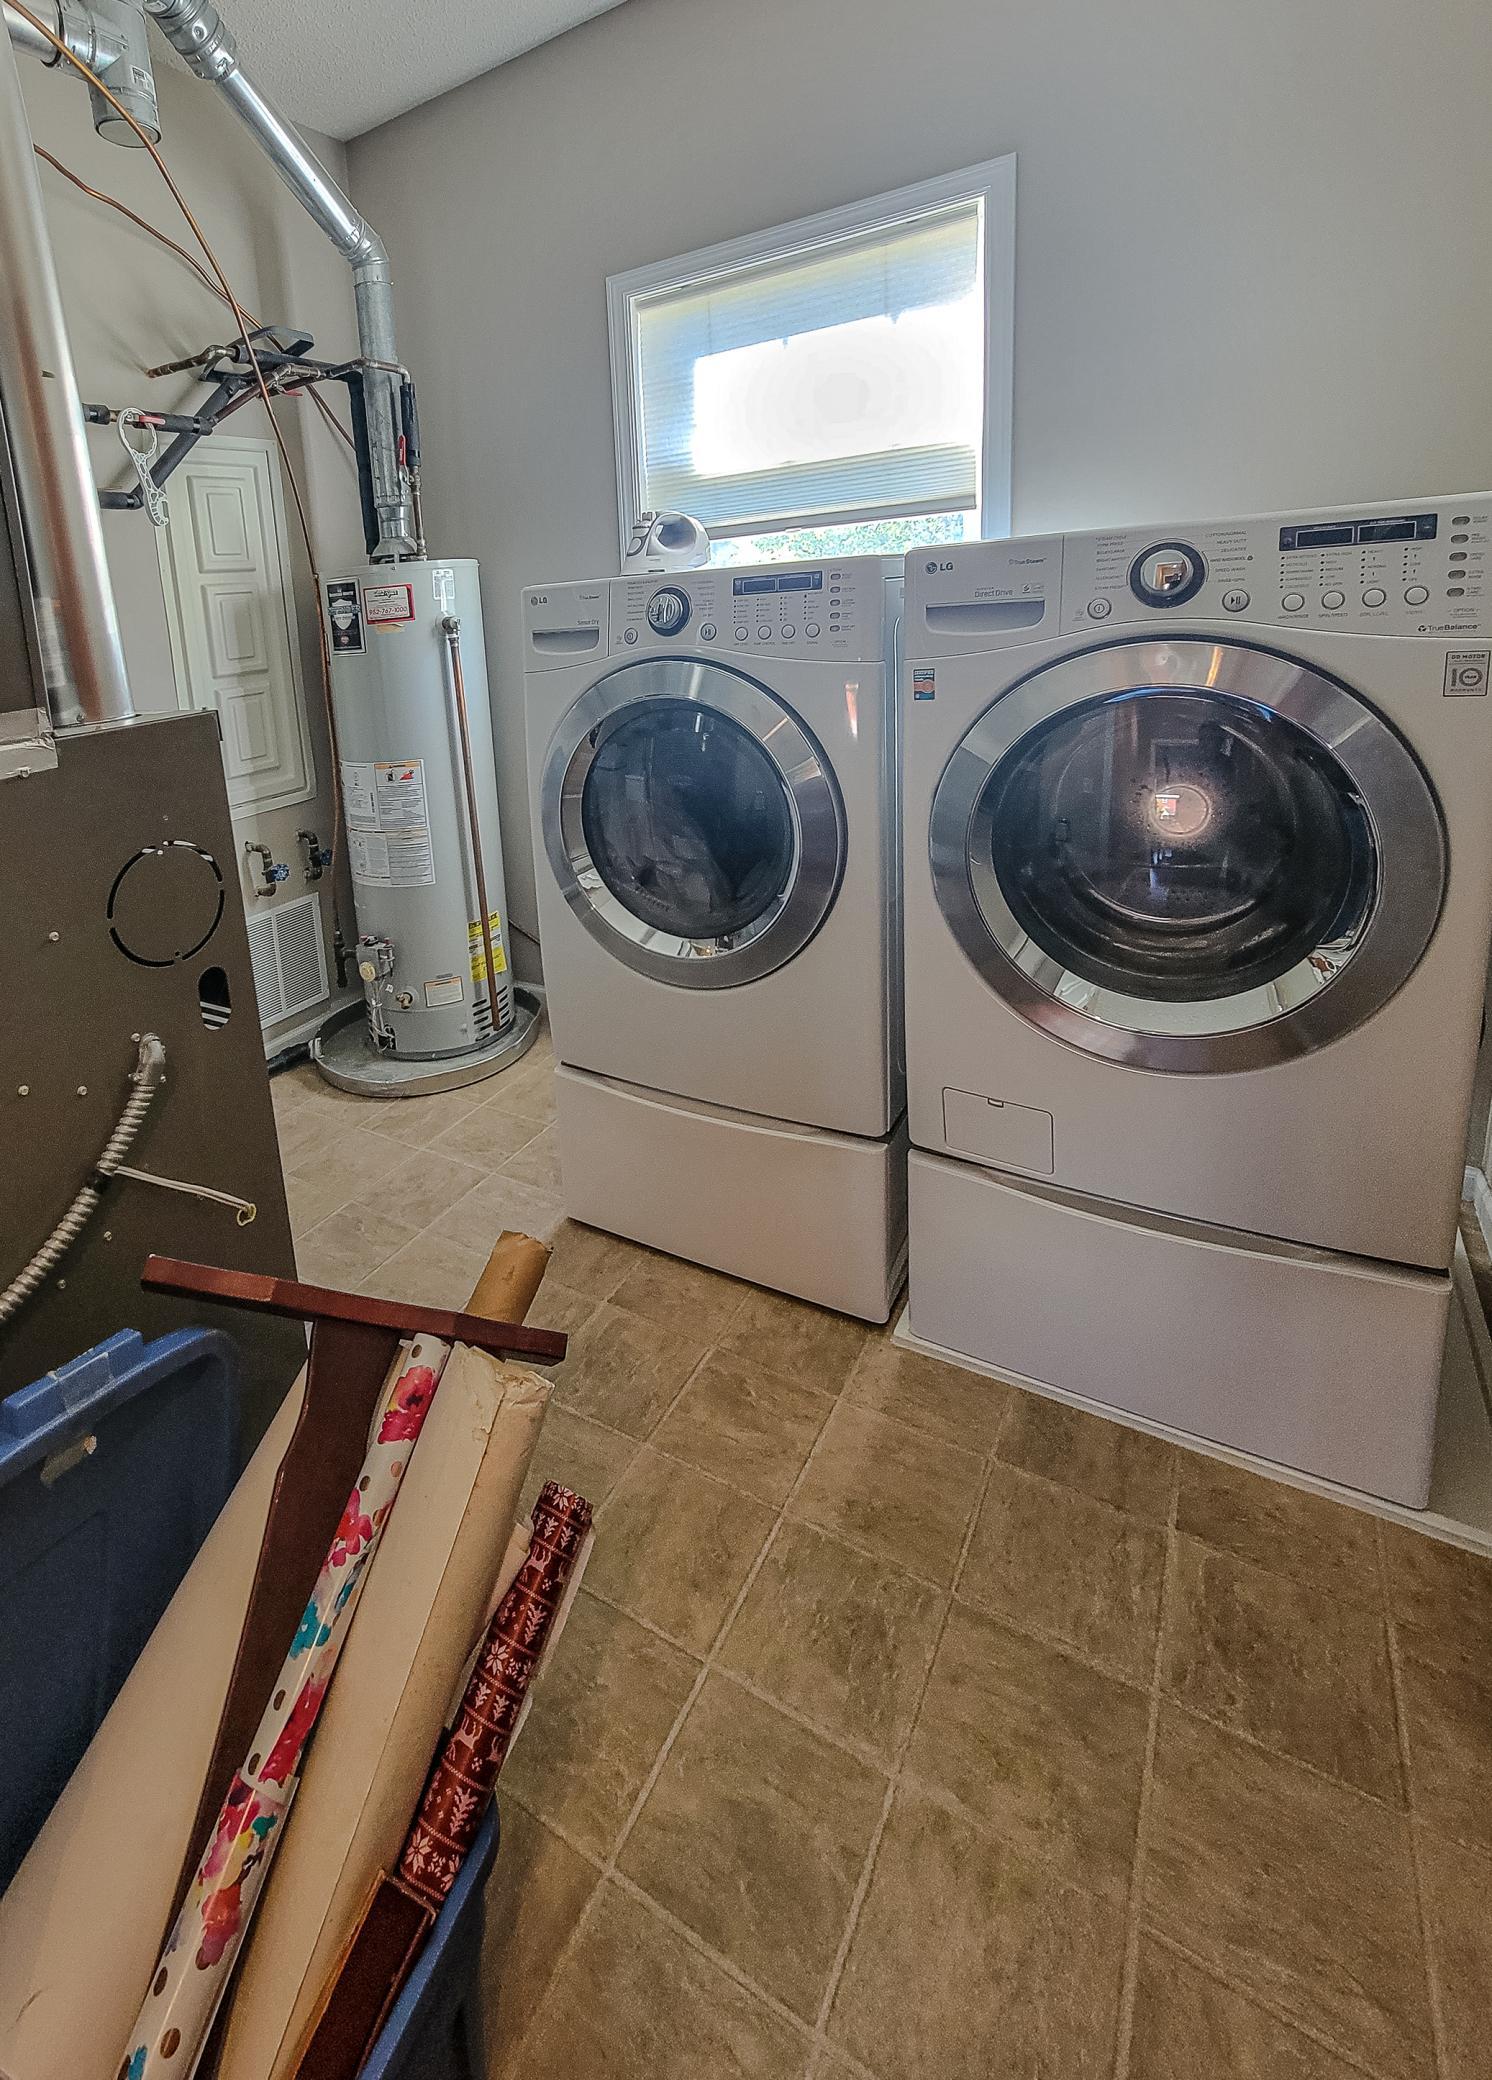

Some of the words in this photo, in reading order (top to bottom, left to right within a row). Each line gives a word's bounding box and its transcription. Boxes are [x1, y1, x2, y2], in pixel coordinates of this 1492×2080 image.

[939, 561, 954, 571] LG
[974, 590, 995, 598] Direct
[995, 589, 1014, 597] Drive
[538, 596, 548, 604] LG
[369, 606, 408, 616] 952-767-1000
